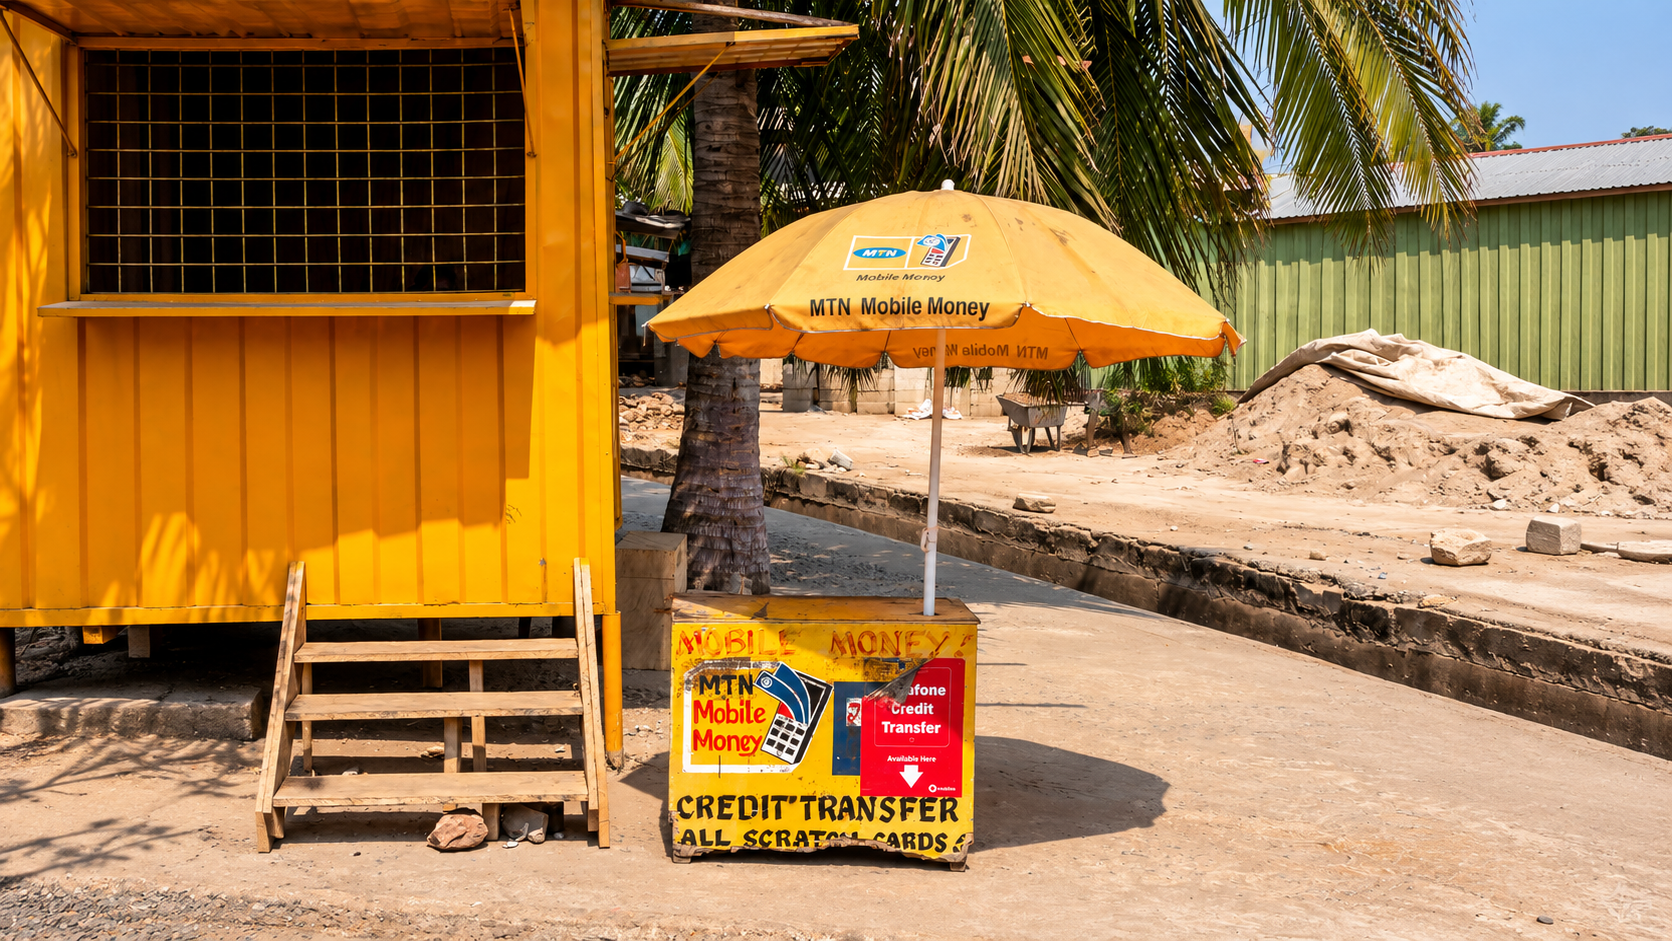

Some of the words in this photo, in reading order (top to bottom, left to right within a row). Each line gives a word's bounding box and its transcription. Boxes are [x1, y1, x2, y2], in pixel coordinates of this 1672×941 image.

[862, 249, 898, 258] MTN
[856, 273, 900, 281] Mobile
[810, 297, 851, 317] MTN
[861, 296, 922, 316] Mobile
[928, 296, 990, 321] Money
[676, 629, 798, 656] MOBILE
[699, 674, 754, 696] MTN
[693, 698, 767, 725] Mobile
[891, 702, 935, 715] Credit
[881, 721, 942, 734] Transfer
[692, 728, 763, 757] Money
[920, 755, 937, 763] Here
[799, 795, 959, 823] TRANSFER
[681, 828, 732, 847] ALL
